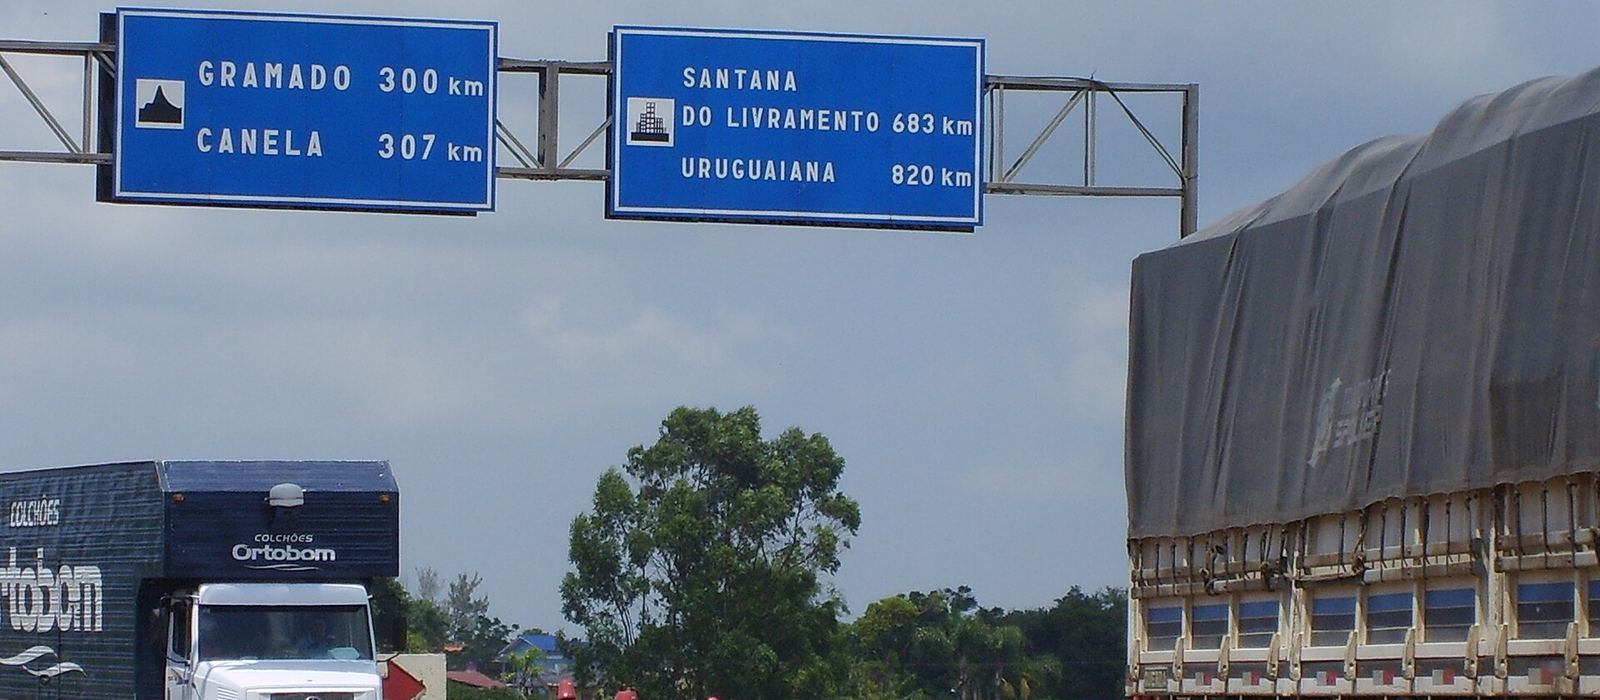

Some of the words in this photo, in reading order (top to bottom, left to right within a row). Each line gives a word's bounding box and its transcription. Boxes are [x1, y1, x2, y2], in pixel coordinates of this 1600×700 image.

[198, 60, 351, 91] GRAMADO
[379, 67, 438, 94] 300
[449, 76, 484, 97] km
[683, 67, 798, 92] SANTANA
[682, 105, 712, 127] DO
[727, 107, 879, 133] LIVRAMENTO
[892, 113, 935, 135] 683
[942, 116, 973, 136] km
[197, 127, 323, 157] CANELA
[378, 133, 436, 160] 307
[448, 142, 483, 163] km
[681, 157, 836, 183] URUGUAIANA
[892, 164, 935, 186] 820
[941, 167, 972, 188] km
[232, 543, 336, 561] Ortobom
